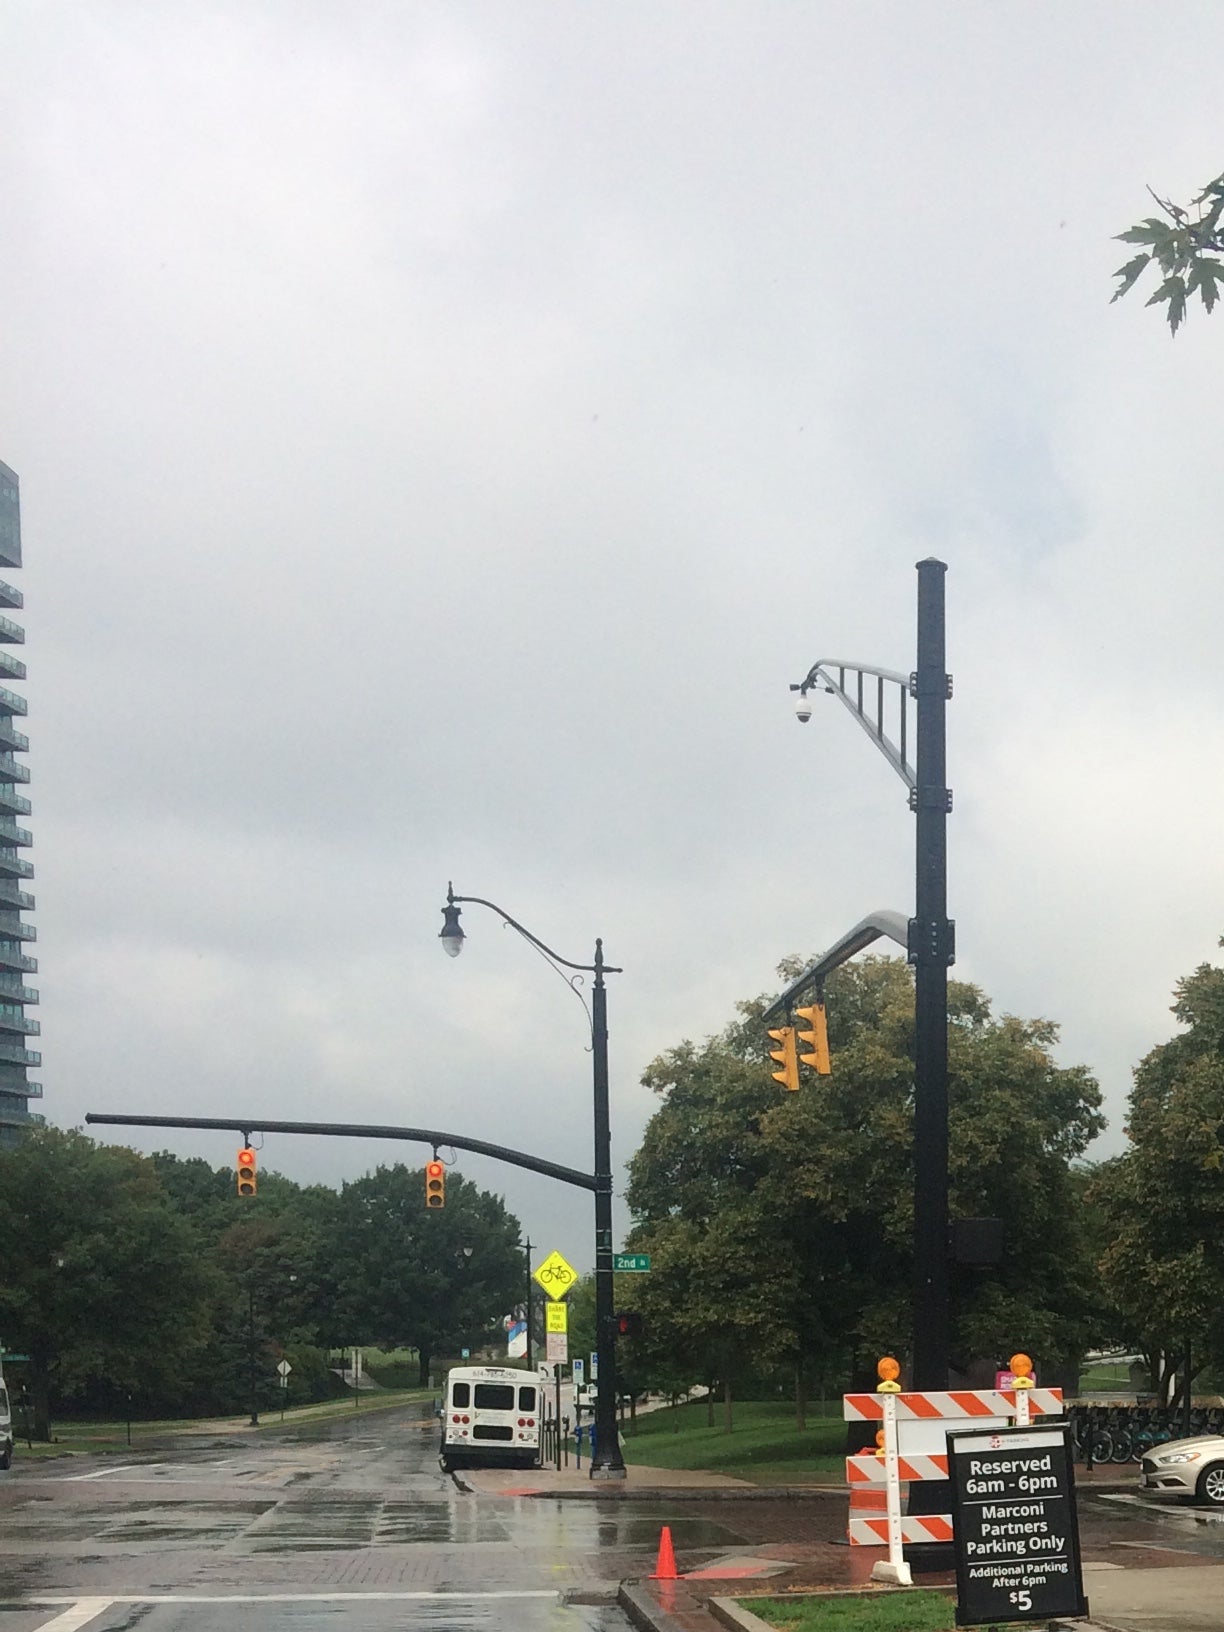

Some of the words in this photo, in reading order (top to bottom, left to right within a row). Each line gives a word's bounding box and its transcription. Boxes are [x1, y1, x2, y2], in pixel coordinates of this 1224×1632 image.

[618, 1257, 636, 1268] 2nd
[970, 1455, 1051, 1475] Reserved
[966, 1478, 1005, 1494] 6am
[1018, 1475, 1057, 1494] 6pm
[982, 1502, 1044, 1519] Marconi
[981, 1521, 1048, 1537] Partners
[967, 1538, 1026, 1556] Parking
[1029, 1536, 1065, 1551] Only
[969, 1564, 1025, 1578] Additional
[1027, 1562, 1068, 1573] Parking
[992, 1577, 1020, 1588] After
[1022, 1575, 1046, 1587] 6pm
[1009, 1590, 1033, 1611] $5
